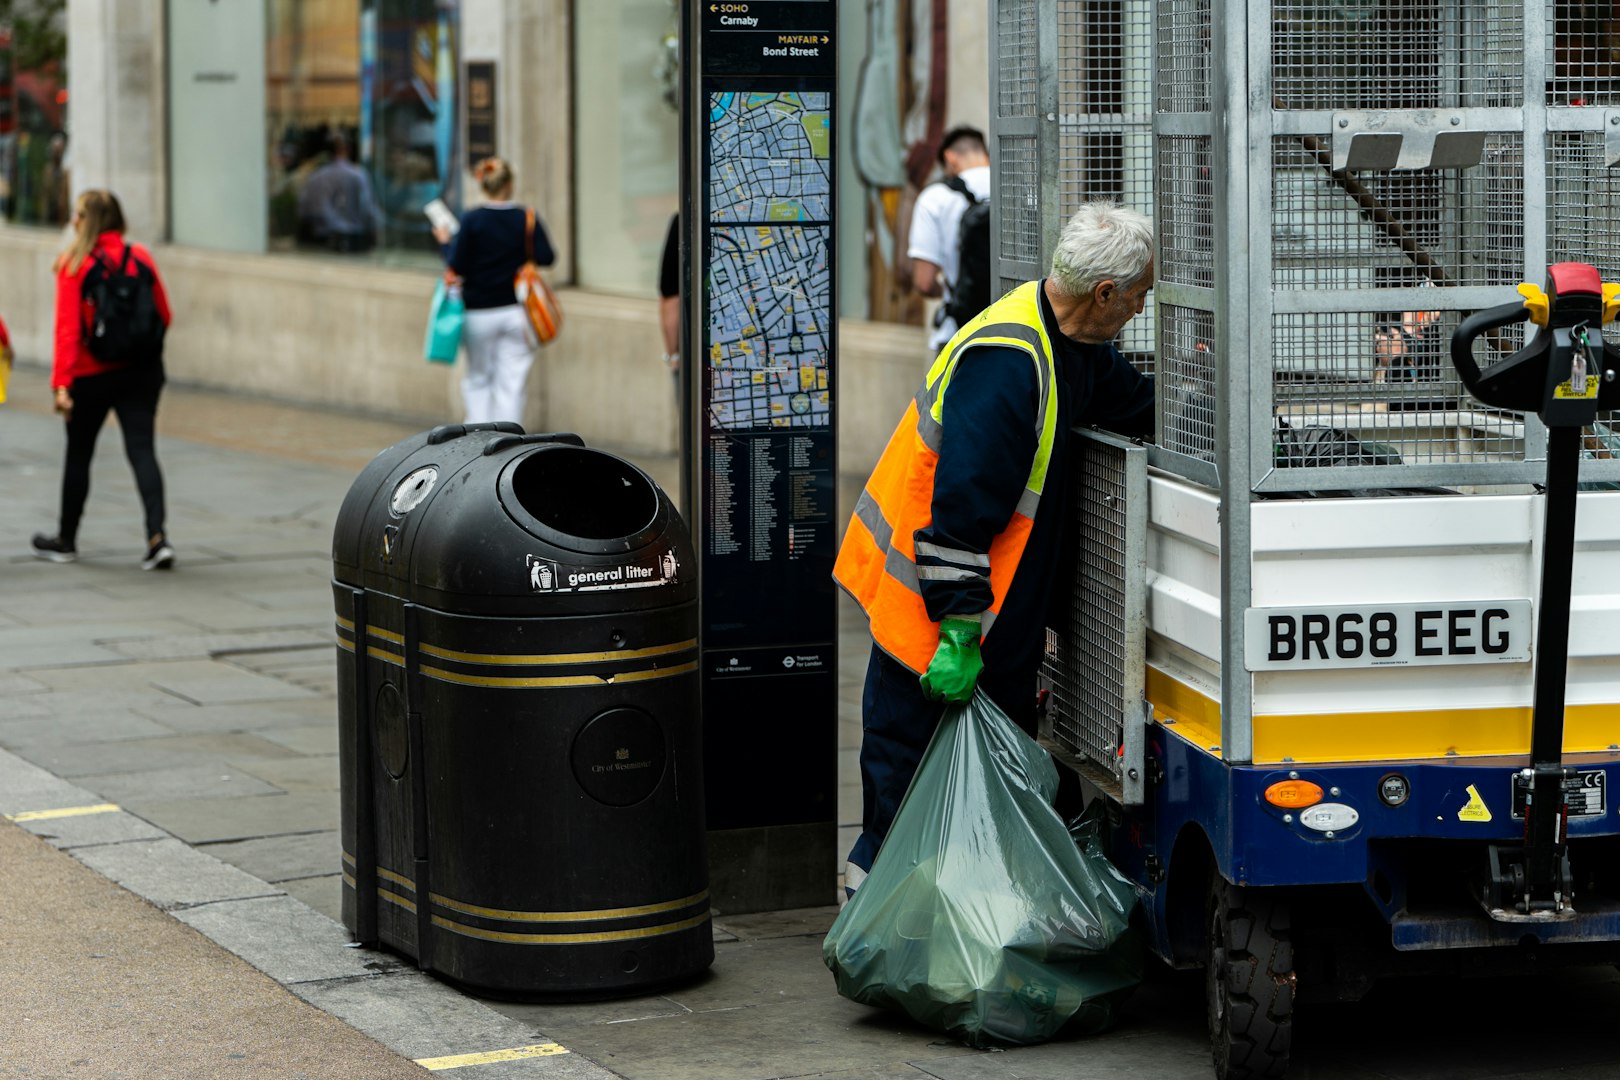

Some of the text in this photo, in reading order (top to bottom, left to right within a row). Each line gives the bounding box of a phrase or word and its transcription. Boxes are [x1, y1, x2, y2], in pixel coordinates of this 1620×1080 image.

[720, 4, 749, 13] SOHO
[720, 16, 759, 27] Carnaby
[778, 36, 819, 44] MAYFAIR
[763, 47, 819, 56] Bond Street
[568, 565, 653, 586] general litter
[1268, 609, 1510, 661] BR68 EEG
[591, 764, 605, 774] City
